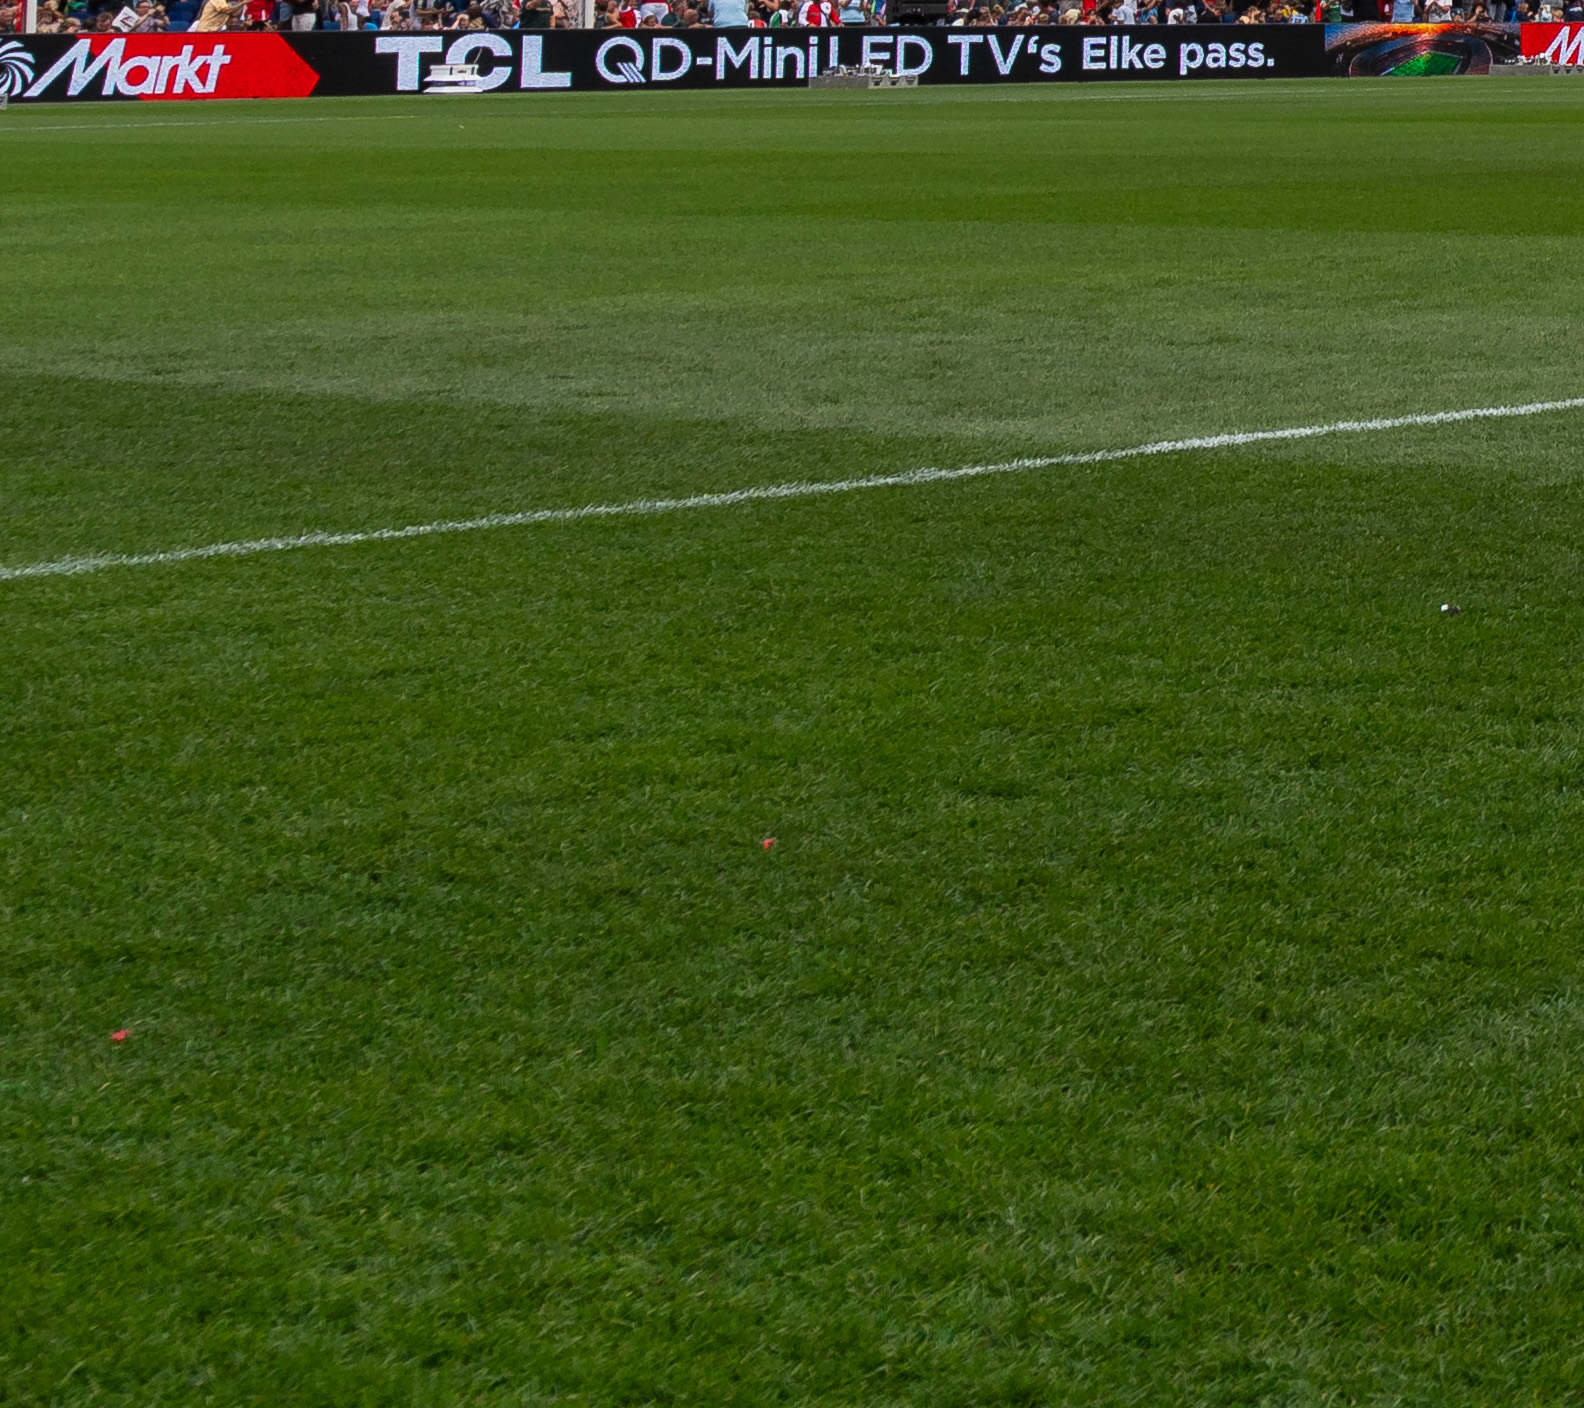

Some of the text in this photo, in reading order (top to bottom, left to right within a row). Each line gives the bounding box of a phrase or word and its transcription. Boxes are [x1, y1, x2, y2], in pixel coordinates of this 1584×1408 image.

[23, 37, 232, 97] Markt
[375, 33, 572, 92] TCL
[1082, 31, 1168, 70] Elke
[1180, 34, 1275, 76] pass.
